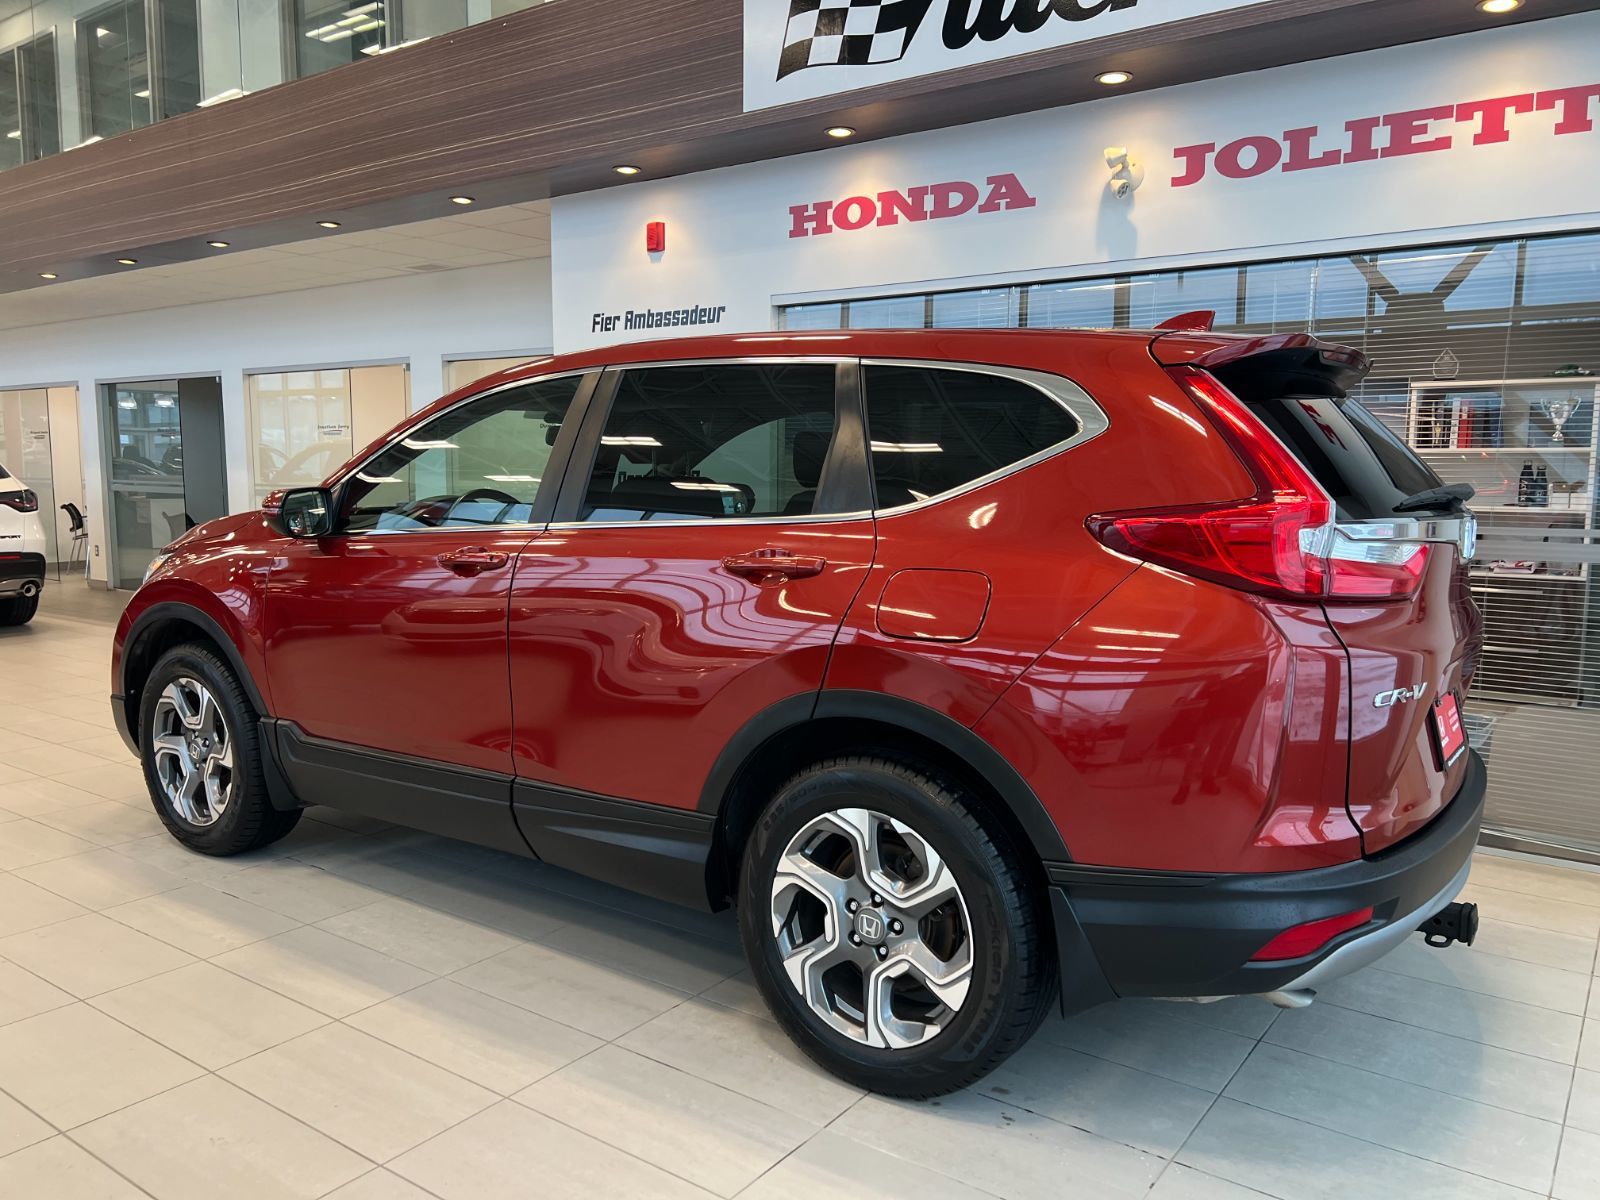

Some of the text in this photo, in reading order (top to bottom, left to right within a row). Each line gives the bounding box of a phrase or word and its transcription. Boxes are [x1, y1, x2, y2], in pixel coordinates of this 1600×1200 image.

[788, 172, 1037, 239] HONDA
[592, 304, 726, 333] Fier Ambassadeur
[1373, 682, 1428, 708] CR-V
